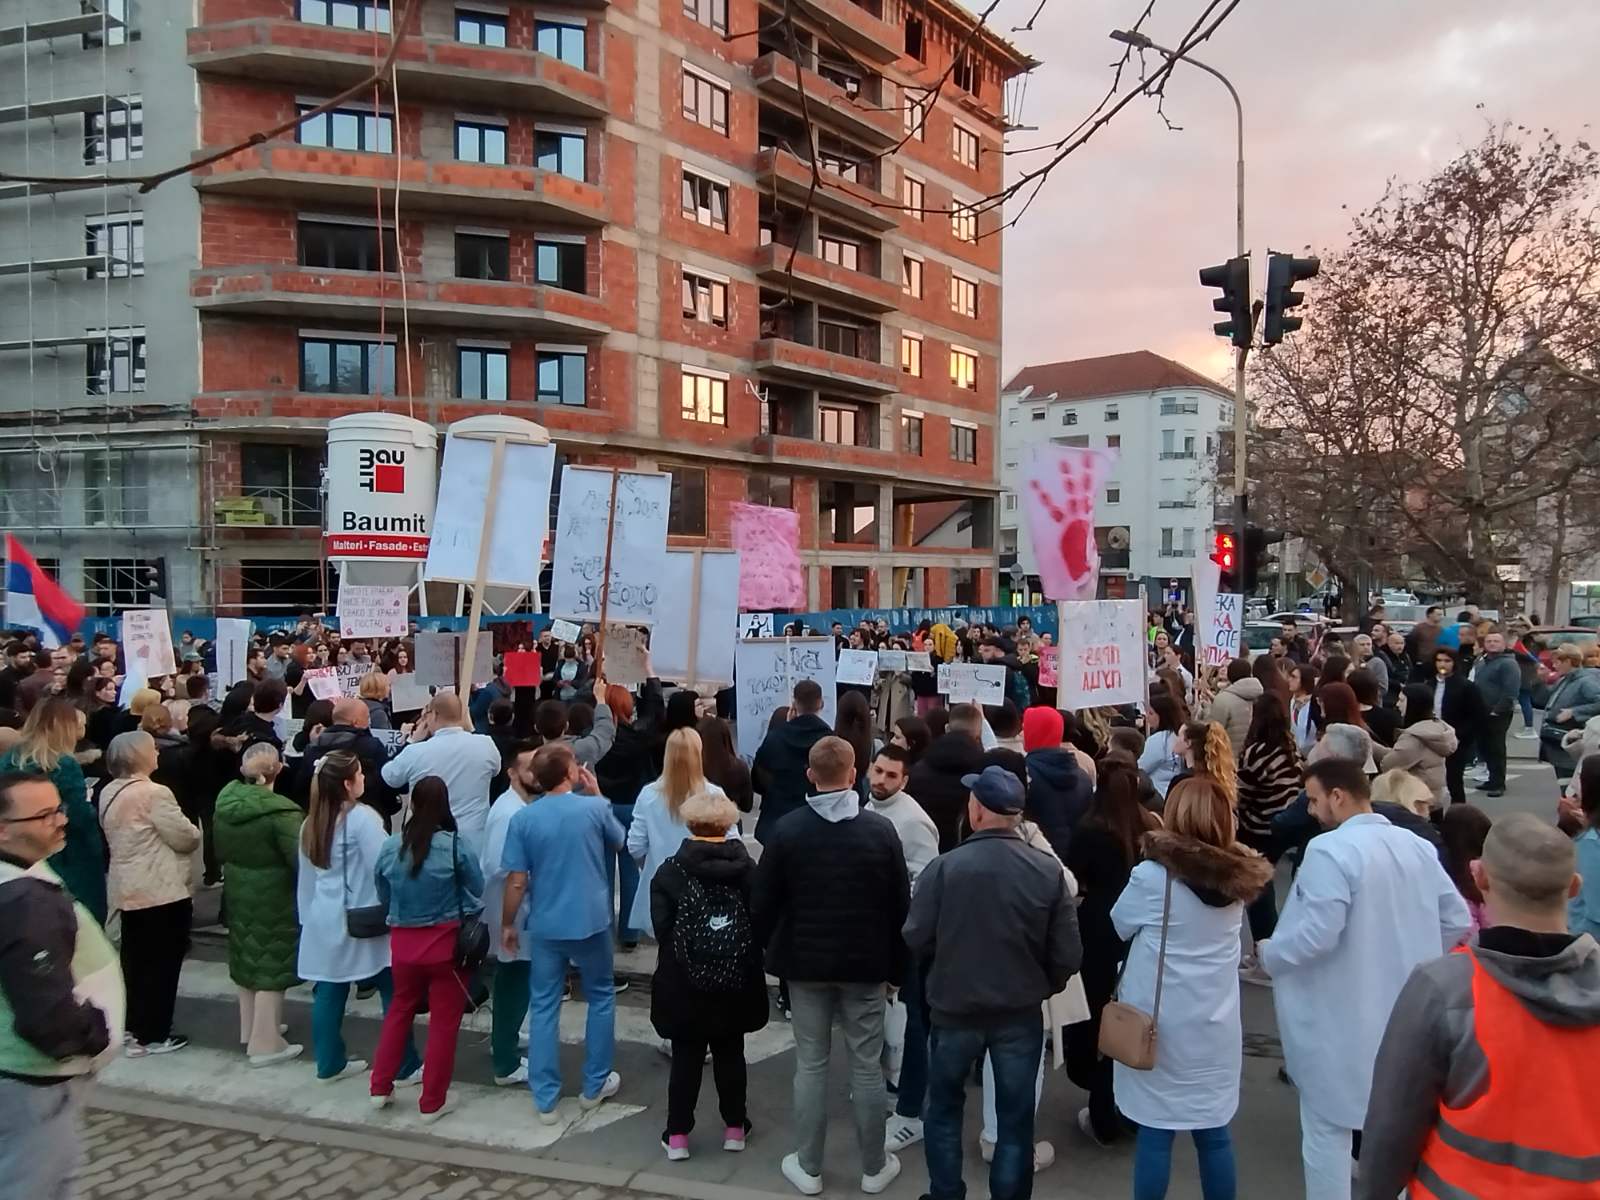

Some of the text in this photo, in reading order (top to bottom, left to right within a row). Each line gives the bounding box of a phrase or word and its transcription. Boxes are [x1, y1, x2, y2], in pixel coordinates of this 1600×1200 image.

[343, 511, 426, 534] Baumit
[333, 540, 363, 551] Malteri
[368, 541, 408, 552] Fasade
